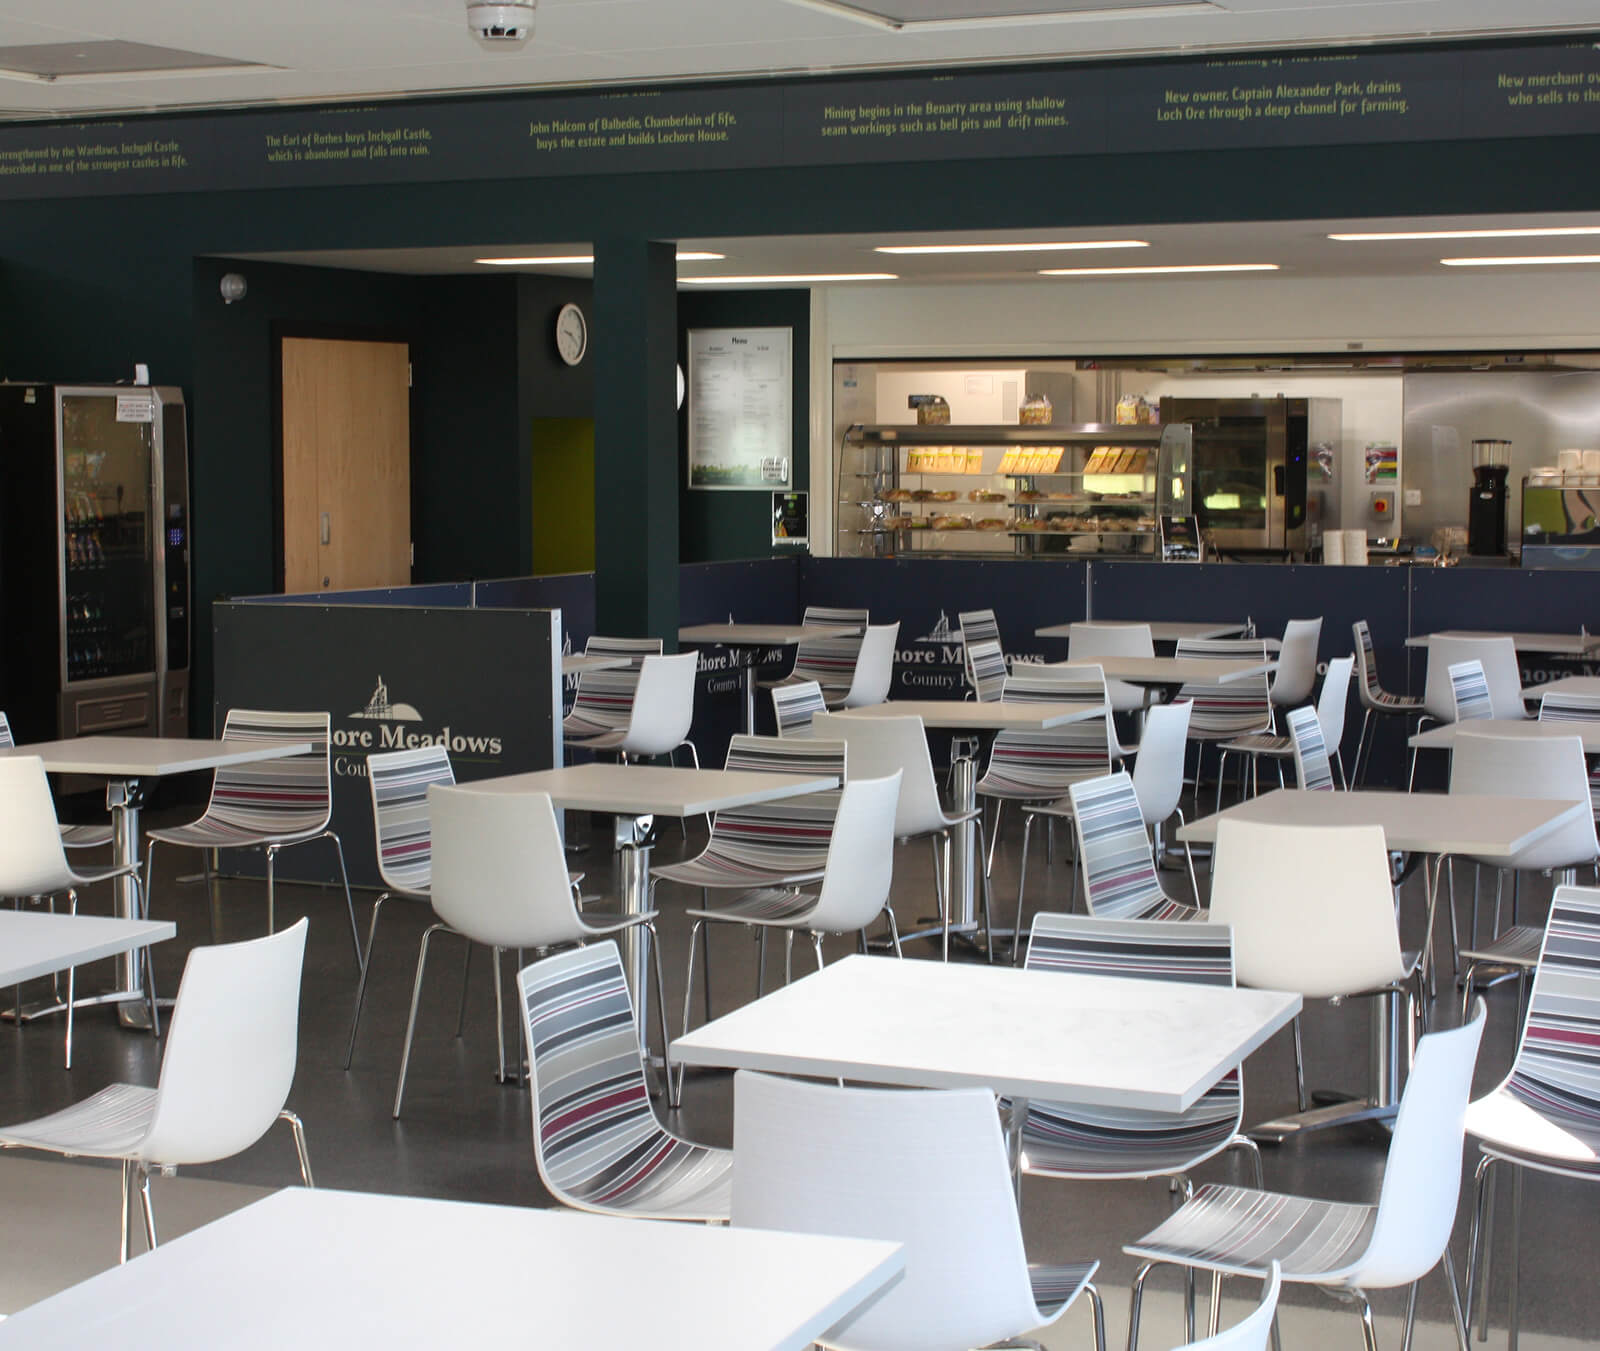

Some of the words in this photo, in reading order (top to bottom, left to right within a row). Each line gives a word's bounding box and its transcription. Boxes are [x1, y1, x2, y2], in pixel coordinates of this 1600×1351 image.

[1498, 73, 1524, 88] New
[1528, 72, 1584, 86] merchant
[1165, 91, 1190, 103] New
[1232, 86, 1272, 103] Captain
[1276, 84, 1331, 98] Alexander
[1335, 83, 1363, 97] Park,
[1367, 81, 1401, 94] drains
[1508, 91, 1533, 105] who
[1537, 90, 1563, 104] sells
[1568, 91, 1579, 102] to
[824, 106, 856, 121] Mining
[859, 104, 891, 120] begins
[894, 104, 903, 116] in
[907, 103, 923, 116] the
[926, 101, 966, 117] Benarty
[969, 101, 992, 113] area
[994, 99, 1022, 114] using
[1026, 96, 1065, 110] shallow
[1157, 107, 1182, 121] Loch
[1185, 106, 1205, 120] Ore
[1209, 104, 1251, 120] through
[1255, 107, 1262, 117] a
[1264, 103, 1291, 119] deep
[1294, 101, 1336, 115] channel
[1340, 99, 1357, 116] for
[1361, 98, 1409, 115] farming.
[529, 121, 549, 136] John
[552, 119, 586, 133] Malcom
[589, 118, 598, 134] of
[644, 114, 701, 129] Chamberlain
[704, 113, 716, 128] of
[821, 126, 847, 137] seam
[850, 122, 896, 136] workings
[900, 120, 923, 132] such
[926, 122, 937, 131] as
[940, 118, 958, 130] bell
[961, 117, 980, 132] pits
[983, 116, 1001, 129] and
[1008, 114, 1031, 130] drift
[1035, 113, 1069, 126] mines.
[266, 135, 283, 147] The
[283, 135, 300, 146] Earl
[302, 133, 311, 148] of
[313, 132, 342, 145] Rothes
[345, 131, 365, 145] buys
[368, 129, 401, 145] Inchgall
[536, 137, 558, 152] buys
[560, 136, 575, 149] the
[578, 136, 606, 148] estate
[608, 134, 625, 146] and
[628, 132, 655, 146] builds
[657, 131, 695, 144] Lochore
[697, 129, 728, 142] House.
[51, 147, 60, 160] by
[63, 145, 75, 157] the
[154, 140, 179, 153] Castle
[267, 149, 293, 161] which
[295, 150, 302, 160] is
[304, 148, 349, 160] abandoned
[352, 147, 366, 158] and
[369, 145, 387, 160] falls
[390, 144, 407, 156] into
[410, 144, 430, 155] ruin.
[65, 160, 74, 175] of
[77, 159, 89, 170] the
[92, 158, 129, 172] strongest
[132, 156, 159, 168] castles
[162, 157, 169, 168] in
[902, 671, 956, 690] Country
[379, 724, 502, 755] Meadows
